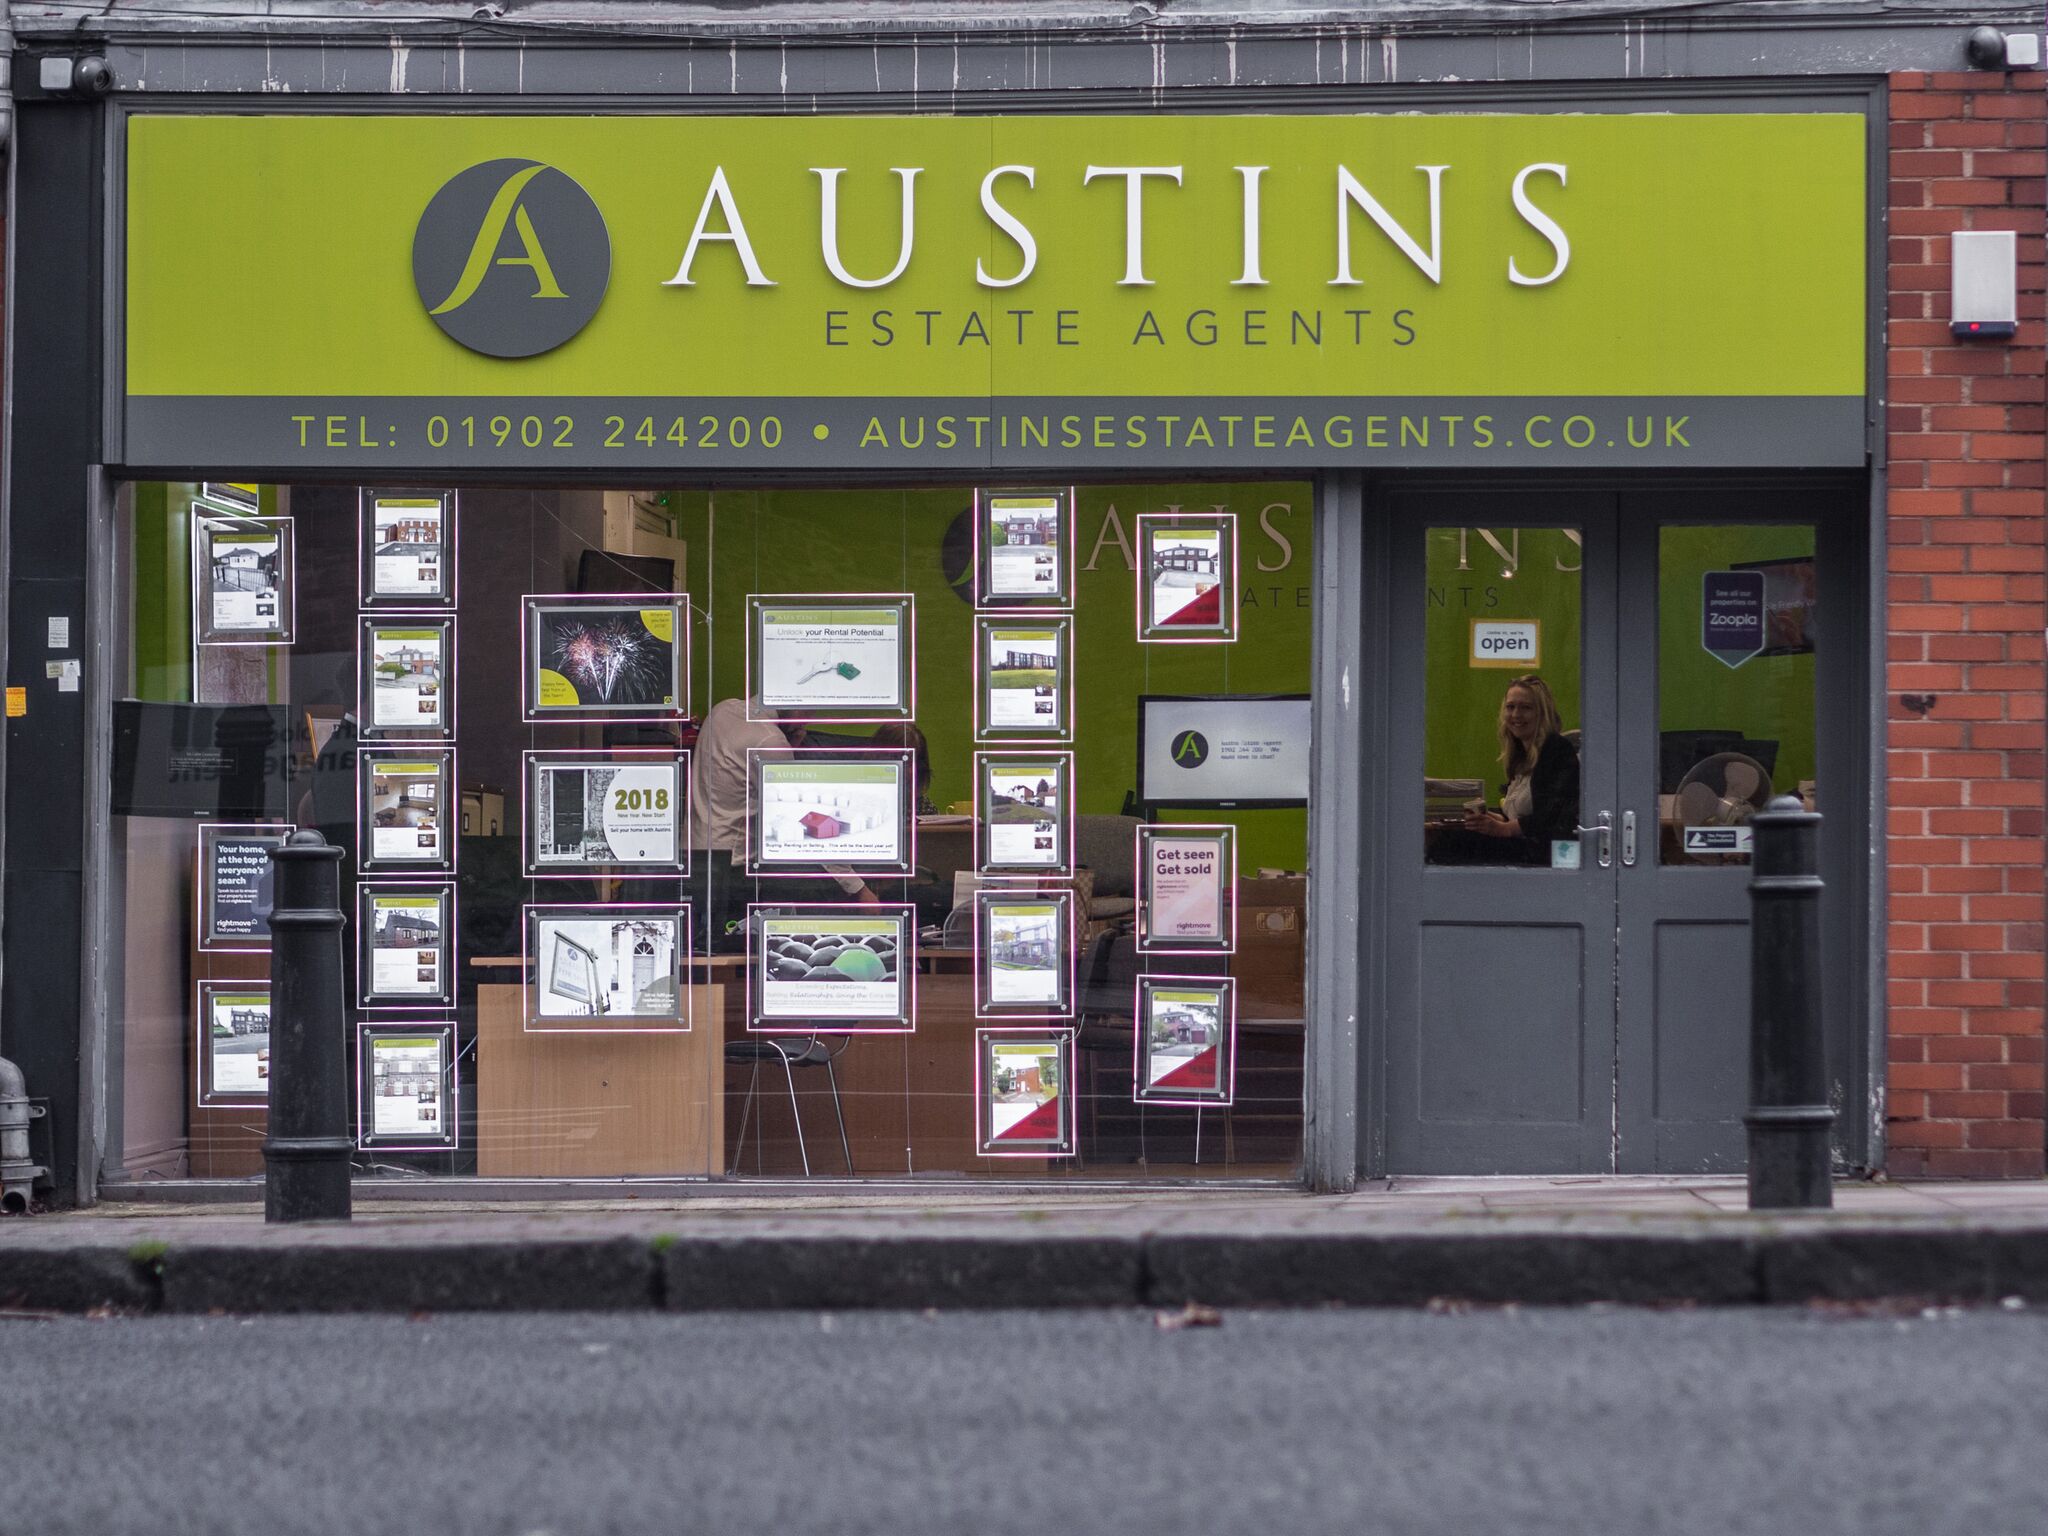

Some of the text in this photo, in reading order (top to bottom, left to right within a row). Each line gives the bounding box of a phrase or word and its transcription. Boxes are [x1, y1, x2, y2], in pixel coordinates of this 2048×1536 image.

[661, 163, 1572, 288] AUSTINS
[826, 309, 1416, 346] ESTATE AGENTS
[291, 415, 1690, 448] TEL: 01902 244200 AUSTINSESTATEAGENTS.CO.UK
[1710, 613, 1757, 627] Zoopla
[777, 628, 884, 639] Unlock your Rental Potential
[1481, 638, 1529, 653] open
[614, 788, 669, 811] 2018
[218, 845, 266, 855] Your home,
[1156, 849, 1215, 860] Get seen
[217, 855, 269, 866] at the top of
[217, 866, 265, 877] everyone's
[1156, 863, 1212, 875] Get sold
[217, 876, 247, 885] search
[216, 919, 251, 928] rightmove
[1176, 922, 1211, 930] rightmove
